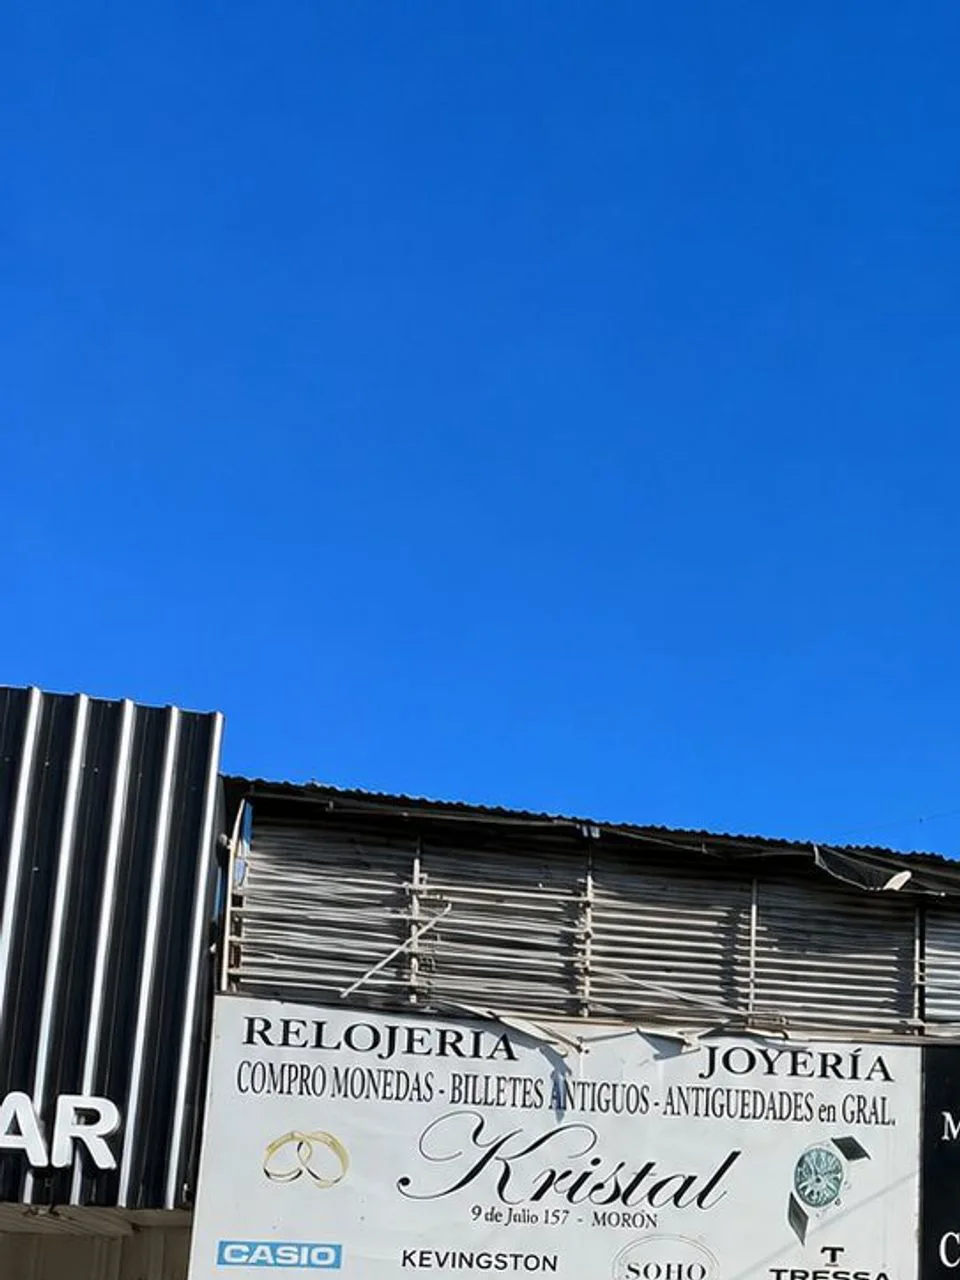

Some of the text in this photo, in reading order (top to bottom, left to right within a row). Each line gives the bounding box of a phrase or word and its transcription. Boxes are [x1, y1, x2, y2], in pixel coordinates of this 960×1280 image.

[242, 1016, 895, 1083] RELOJERIA JOYERÍA
[236, 1060, 897, 1126] COMPRO MONEDAS BILLETES ANTIGUOS ANTIGUEDADES en GRAL.
[396, 1110, 742, 1210] Kristal
[471, 1205, 482, 1222] 9
[484, 1207, 503, 1224] de
[504, 1207, 539, 1227] Julio
[543, 1210, 570, 1226] 157
[222, 1244, 337, 1267] CASIO
[401, 1249, 559, 1273] KEVINGSTON
